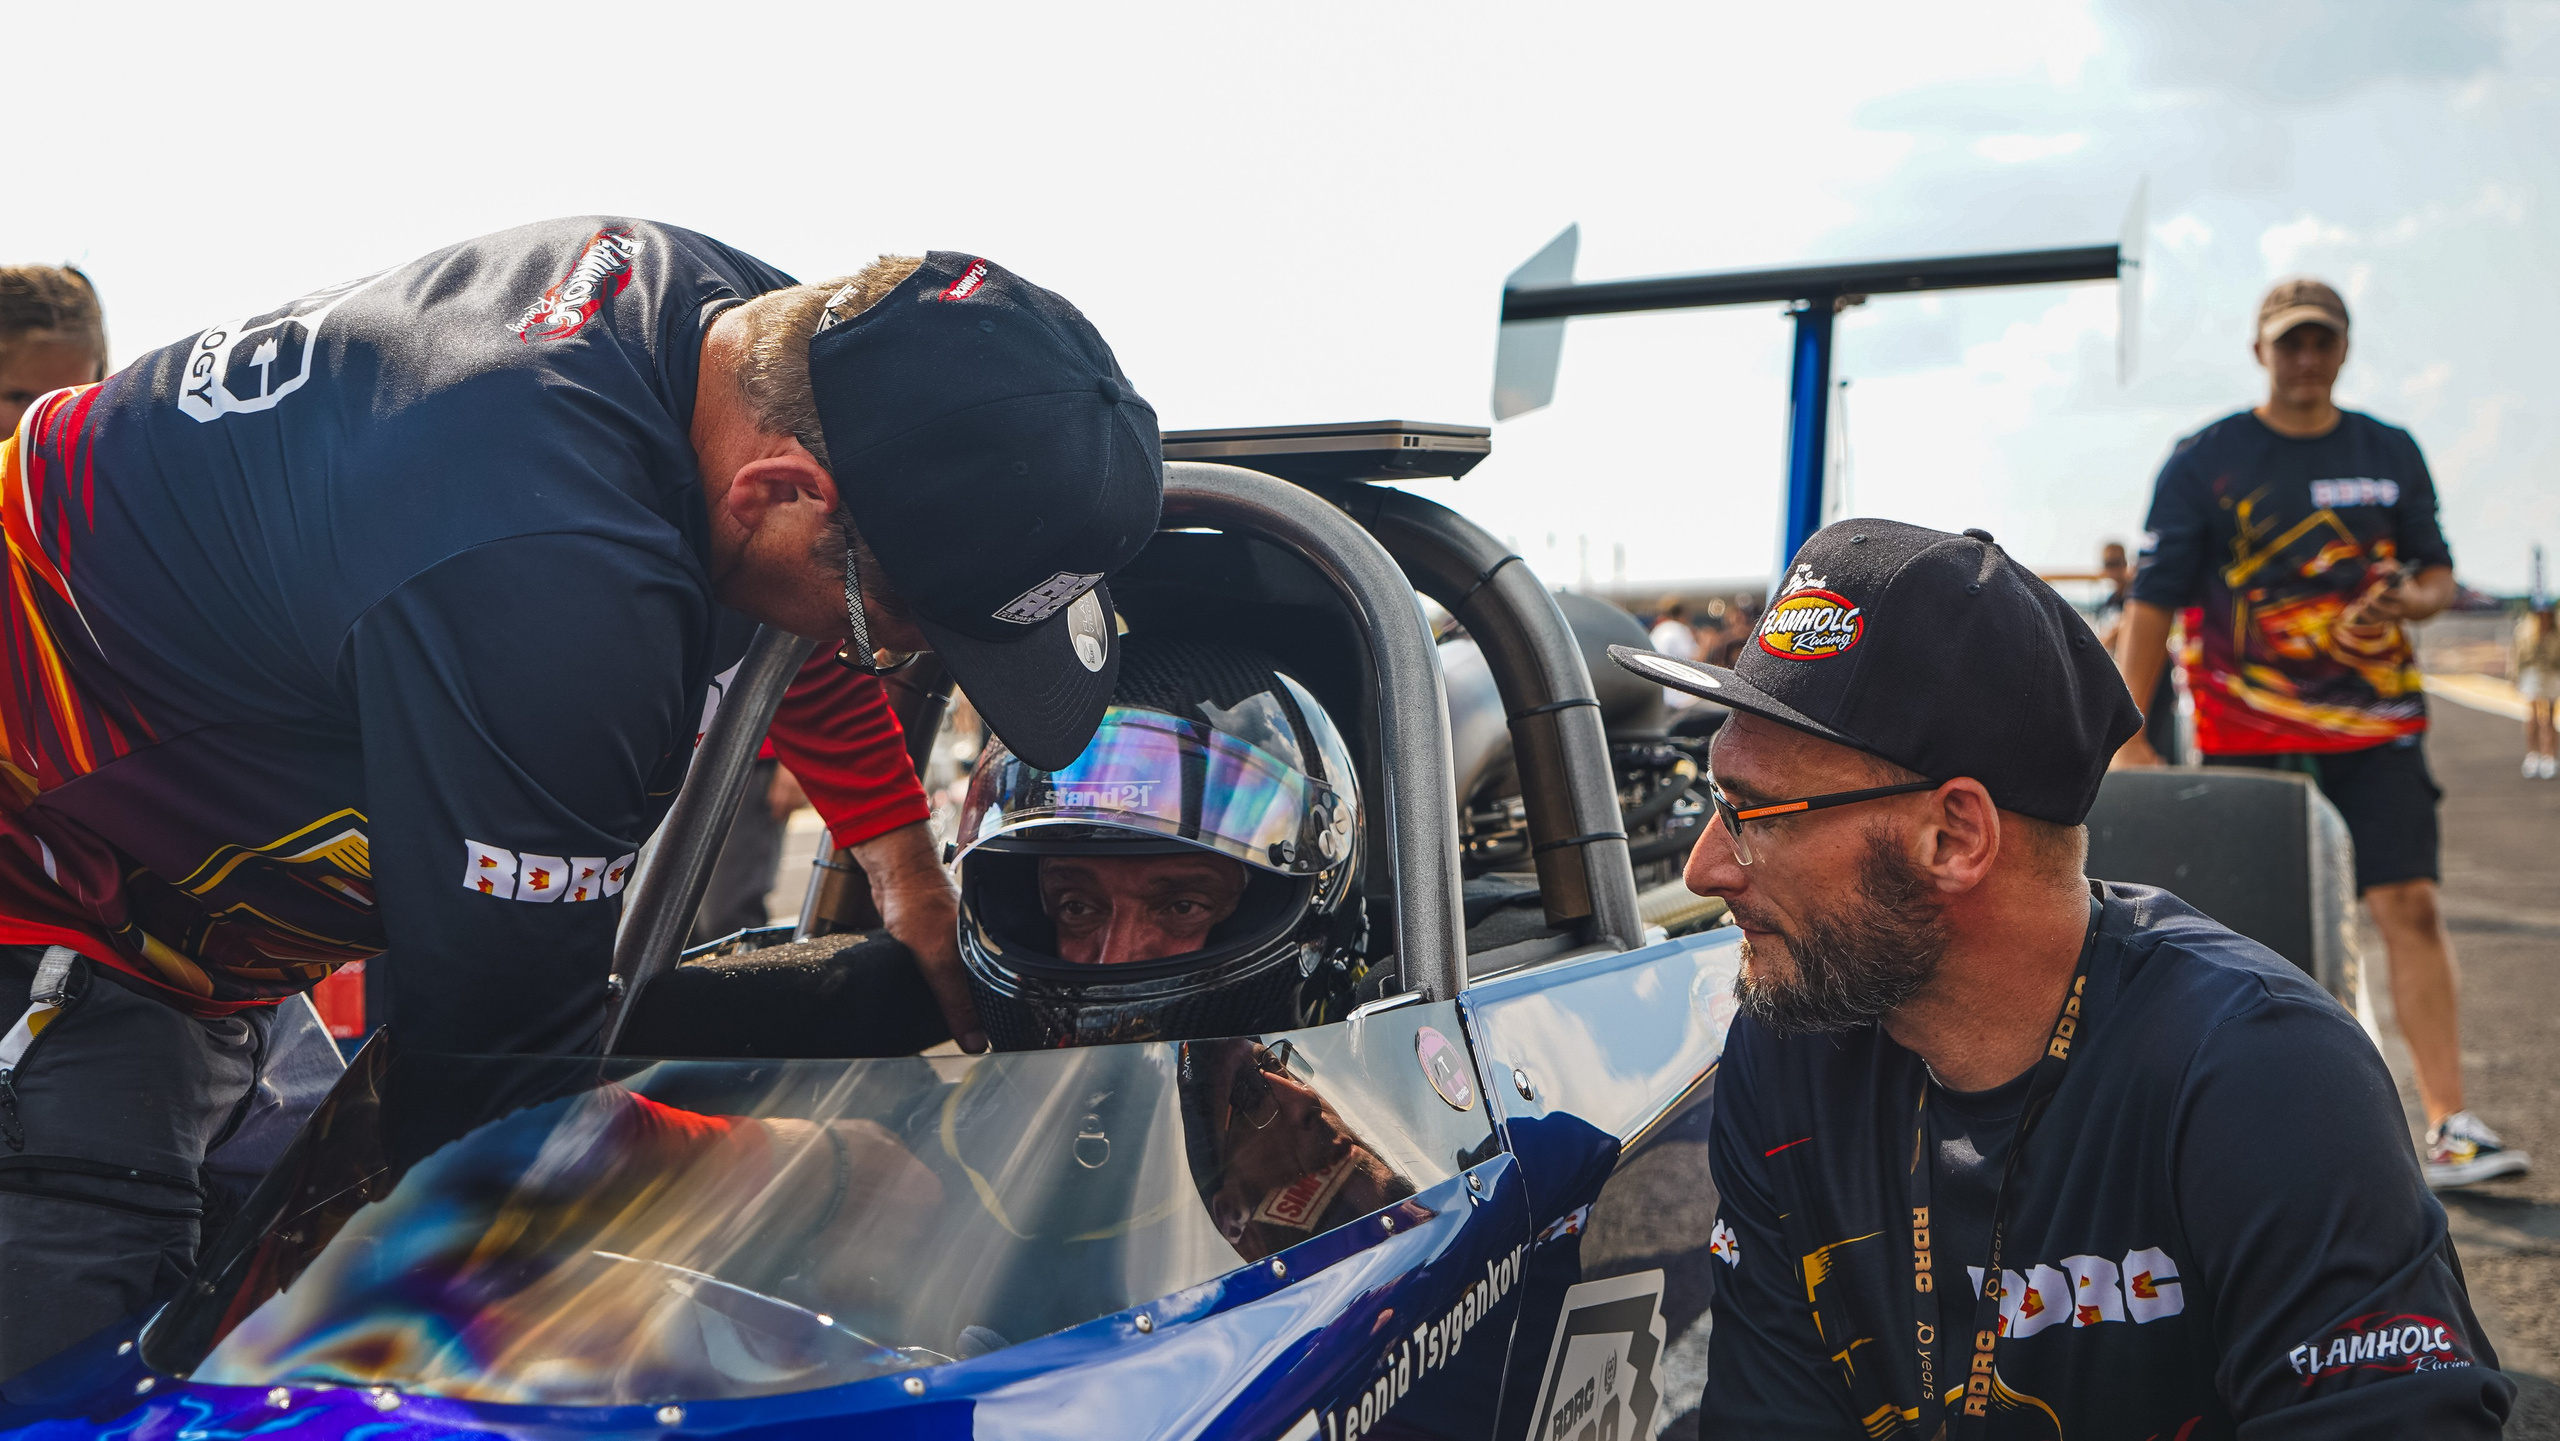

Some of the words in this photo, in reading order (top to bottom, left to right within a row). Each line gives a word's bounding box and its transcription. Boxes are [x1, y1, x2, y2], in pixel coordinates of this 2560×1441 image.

[505, 296, 555, 332] Racing
[1759, 607, 1860, 636] FLAMHOLC
[1792, 631, 1852, 651] Racing
[463, 839, 635, 903] RDRC
[1913, 1206, 1933, 1292] RDRC
[1413, 1244, 1522, 1381] Tsygankov
[1917, 1349, 1934, 1400] years
[1964, 1330, 1996, 1417] RDRC
[2288, 1325, 2451, 1375] FLAMHOLC
